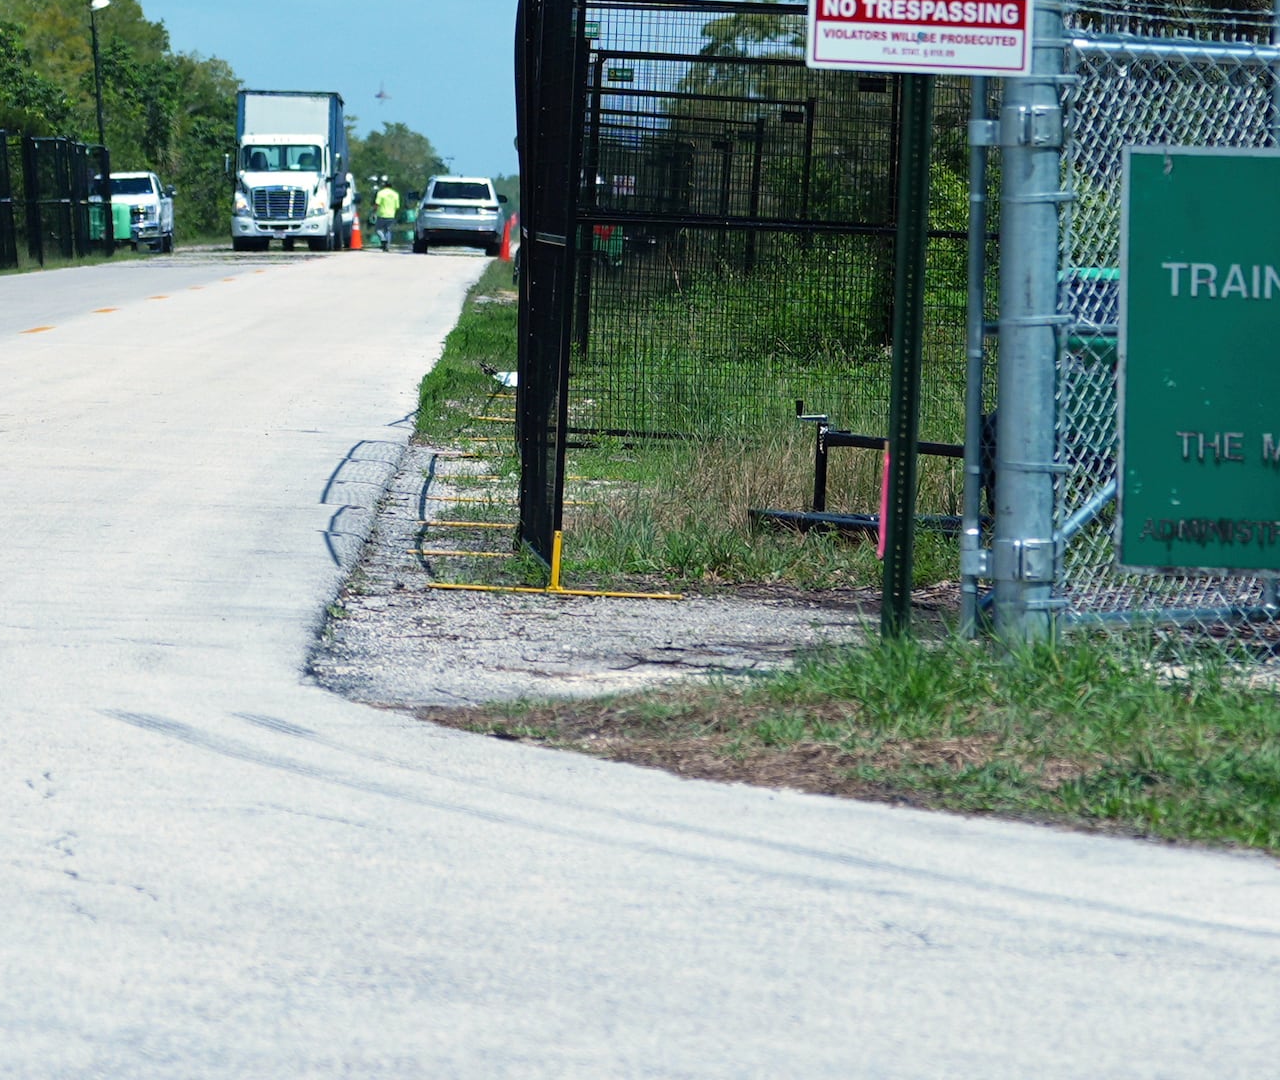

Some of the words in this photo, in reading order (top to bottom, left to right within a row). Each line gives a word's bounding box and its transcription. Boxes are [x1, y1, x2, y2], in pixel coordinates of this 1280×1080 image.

[823, 27, 888, 42] VIOLATORS
[891, 31, 918, 44] WILL
[921, 32, 937, 44] BE
[940, 33, 1018, 47] PROSECUTED
[1176, 431, 1245, 461] THE
